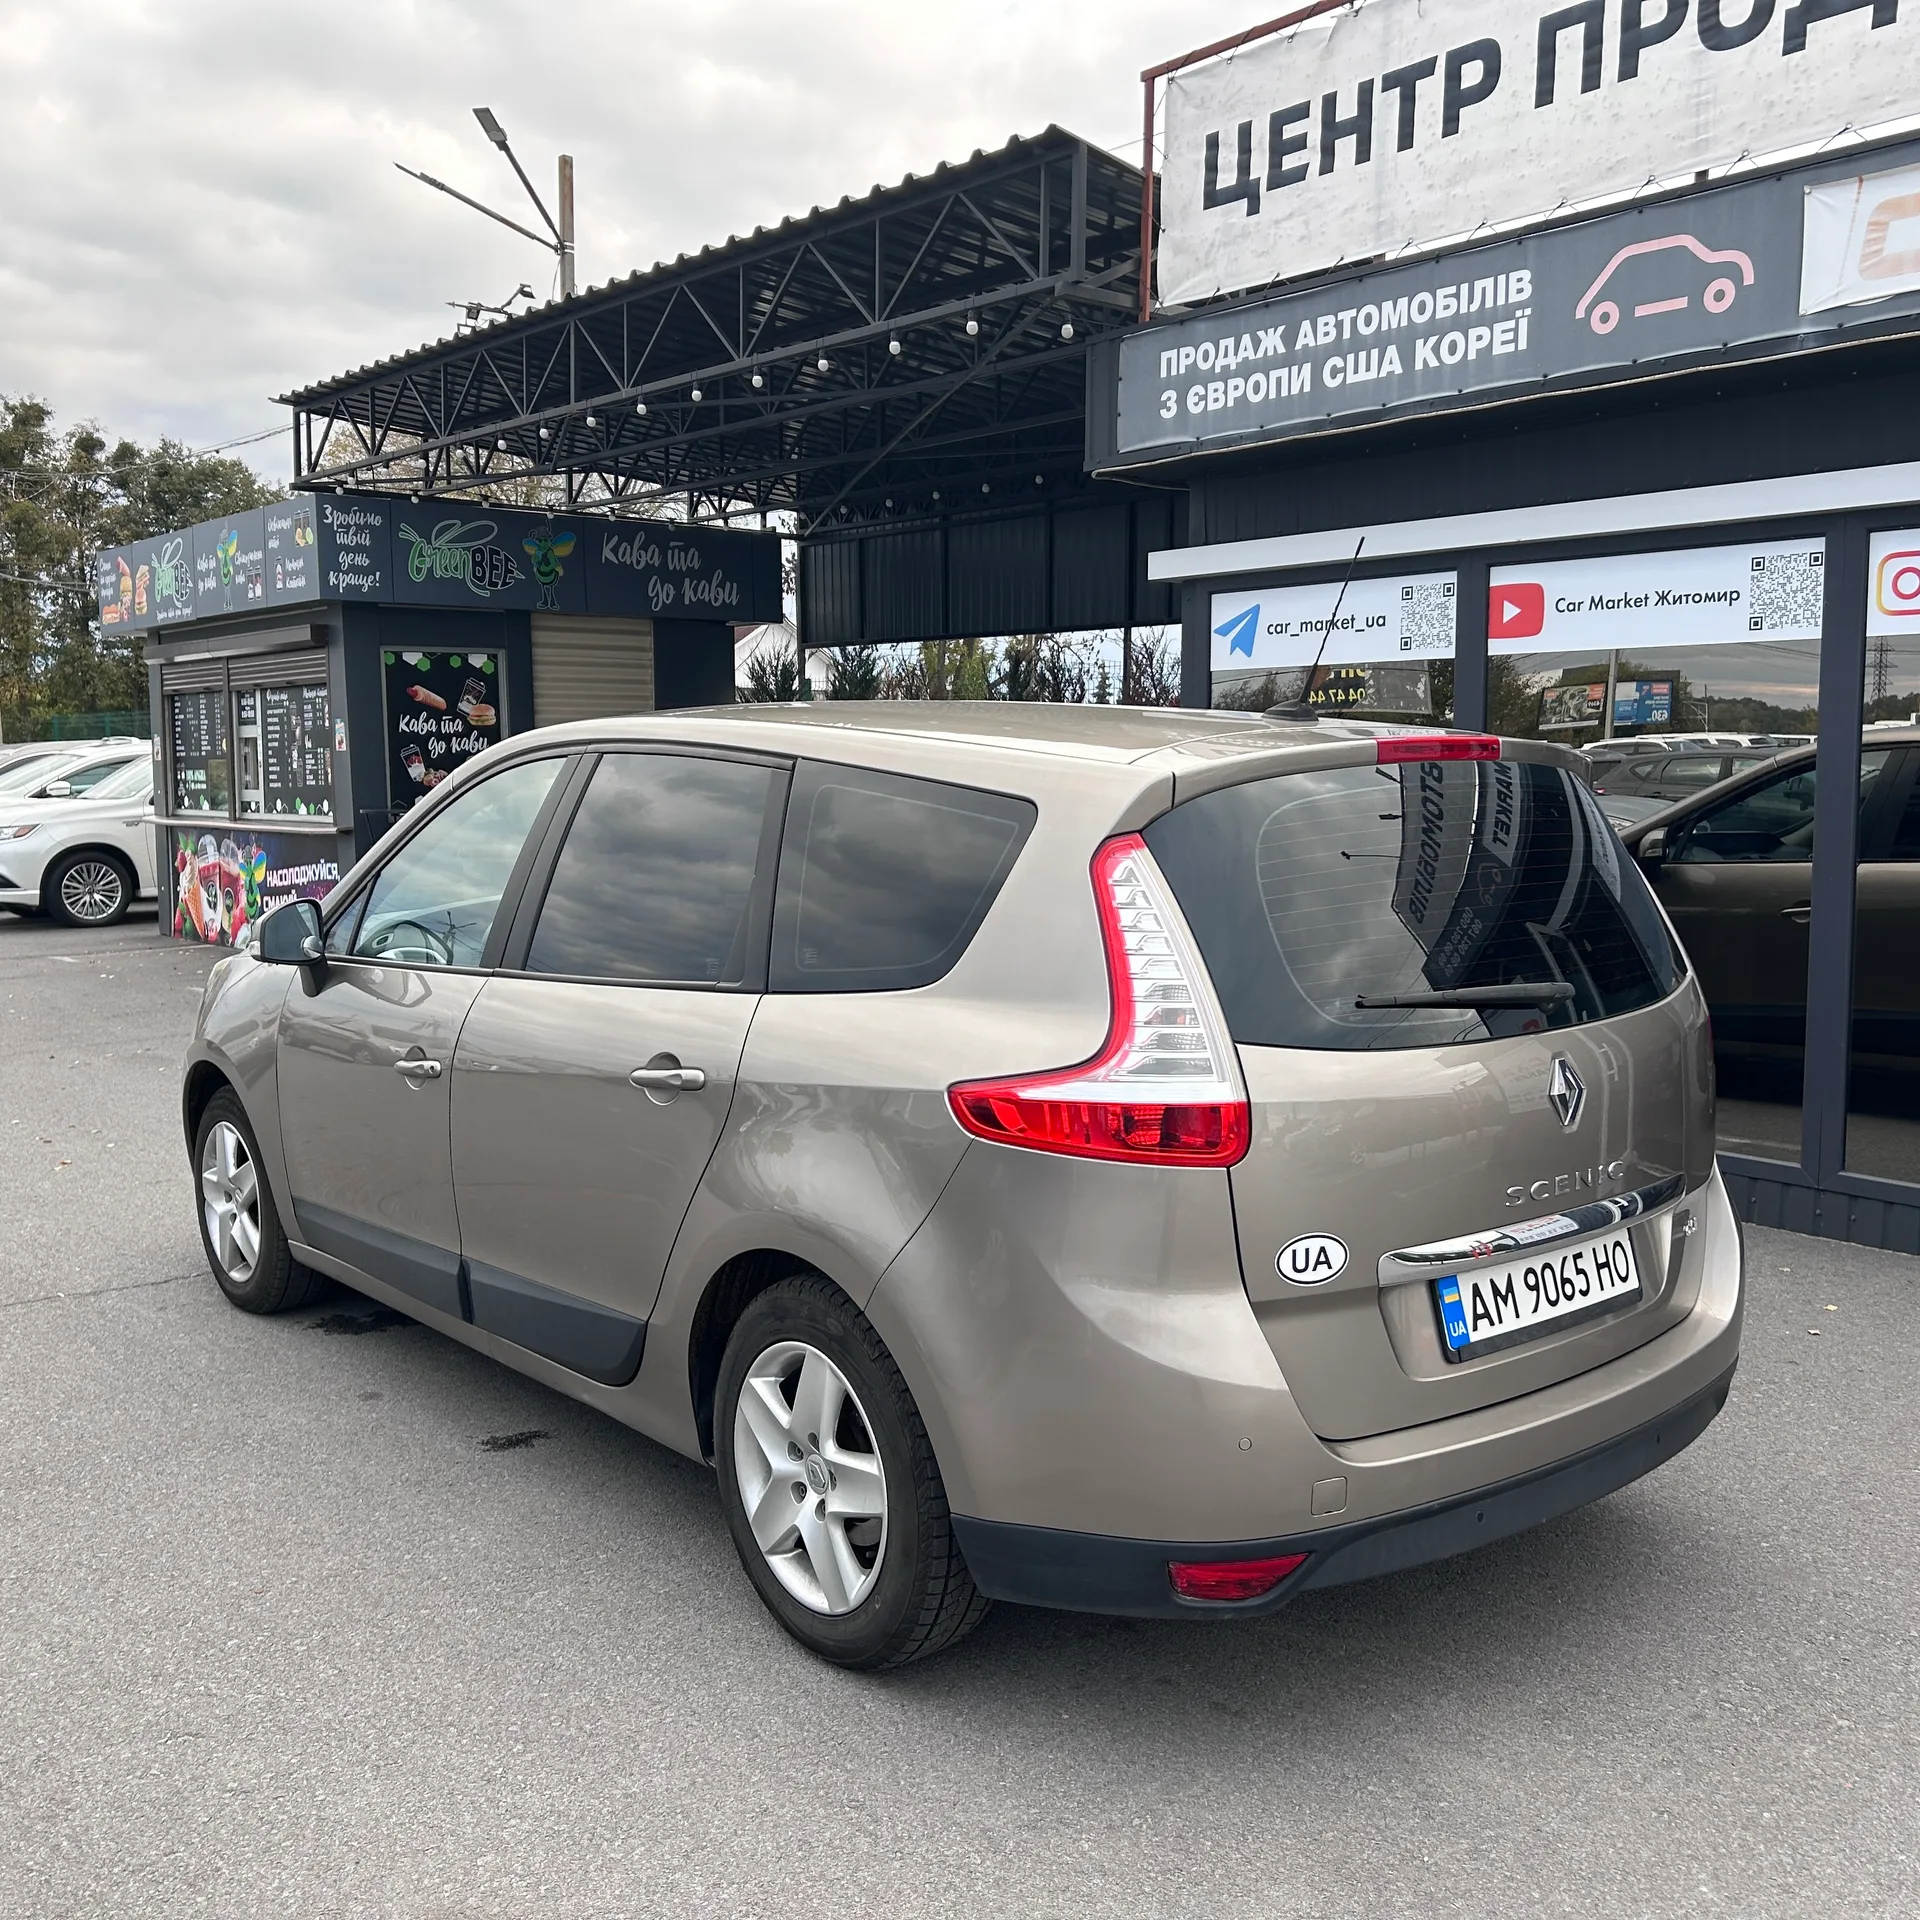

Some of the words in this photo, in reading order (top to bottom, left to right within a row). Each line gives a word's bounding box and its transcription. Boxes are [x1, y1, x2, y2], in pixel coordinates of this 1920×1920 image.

[1203, 38, 1501, 217] ЦЕНТР
[1160, 325, 1286, 379] ПРОДАЖ
[1294, 269, 1533, 350] АВТОМОБІЛІВ
[1160, 390, 1177, 419] З
[1186, 362, 1311, 414] ЄВРОПИ
[1322, 345, 1403, 388] США
[1414, 307, 1533, 371] КОРЕЇ
[323, 505, 382, 530] Зробимо
[336, 529, 371, 547] твій
[602, 531, 662, 570] Кава
[667, 541, 701, 572] та
[338, 552, 370, 570] день
[328, 572, 380, 593] краще!
[648, 575, 675, 612] до
[682, 569, 740, 607] кави
[1555, 598, 1584, 613] Car
[1588, 592, 1650, 611] Market
[1654, 589, 1741, 607] Житомир
[1267, 615, 1387, 637] car_market_ua
[398, 711, 438, 735] Кава
[440, 716, 464, 734] та
[428, 736, 446, 758] до
[450, 730, 489, 753] кави
[266, 858, 341, 887] НАСОЛОДЖУЙСЯ,
[1292, 1246, 1332, 1273] UA
[1472, 1272, 1520, 1332] AM
[1523, 1251, 1591, 1314] 9065
[1592, 1239, 1630, 1291] HO
[1449, 1320, 1467, 1337] UA
